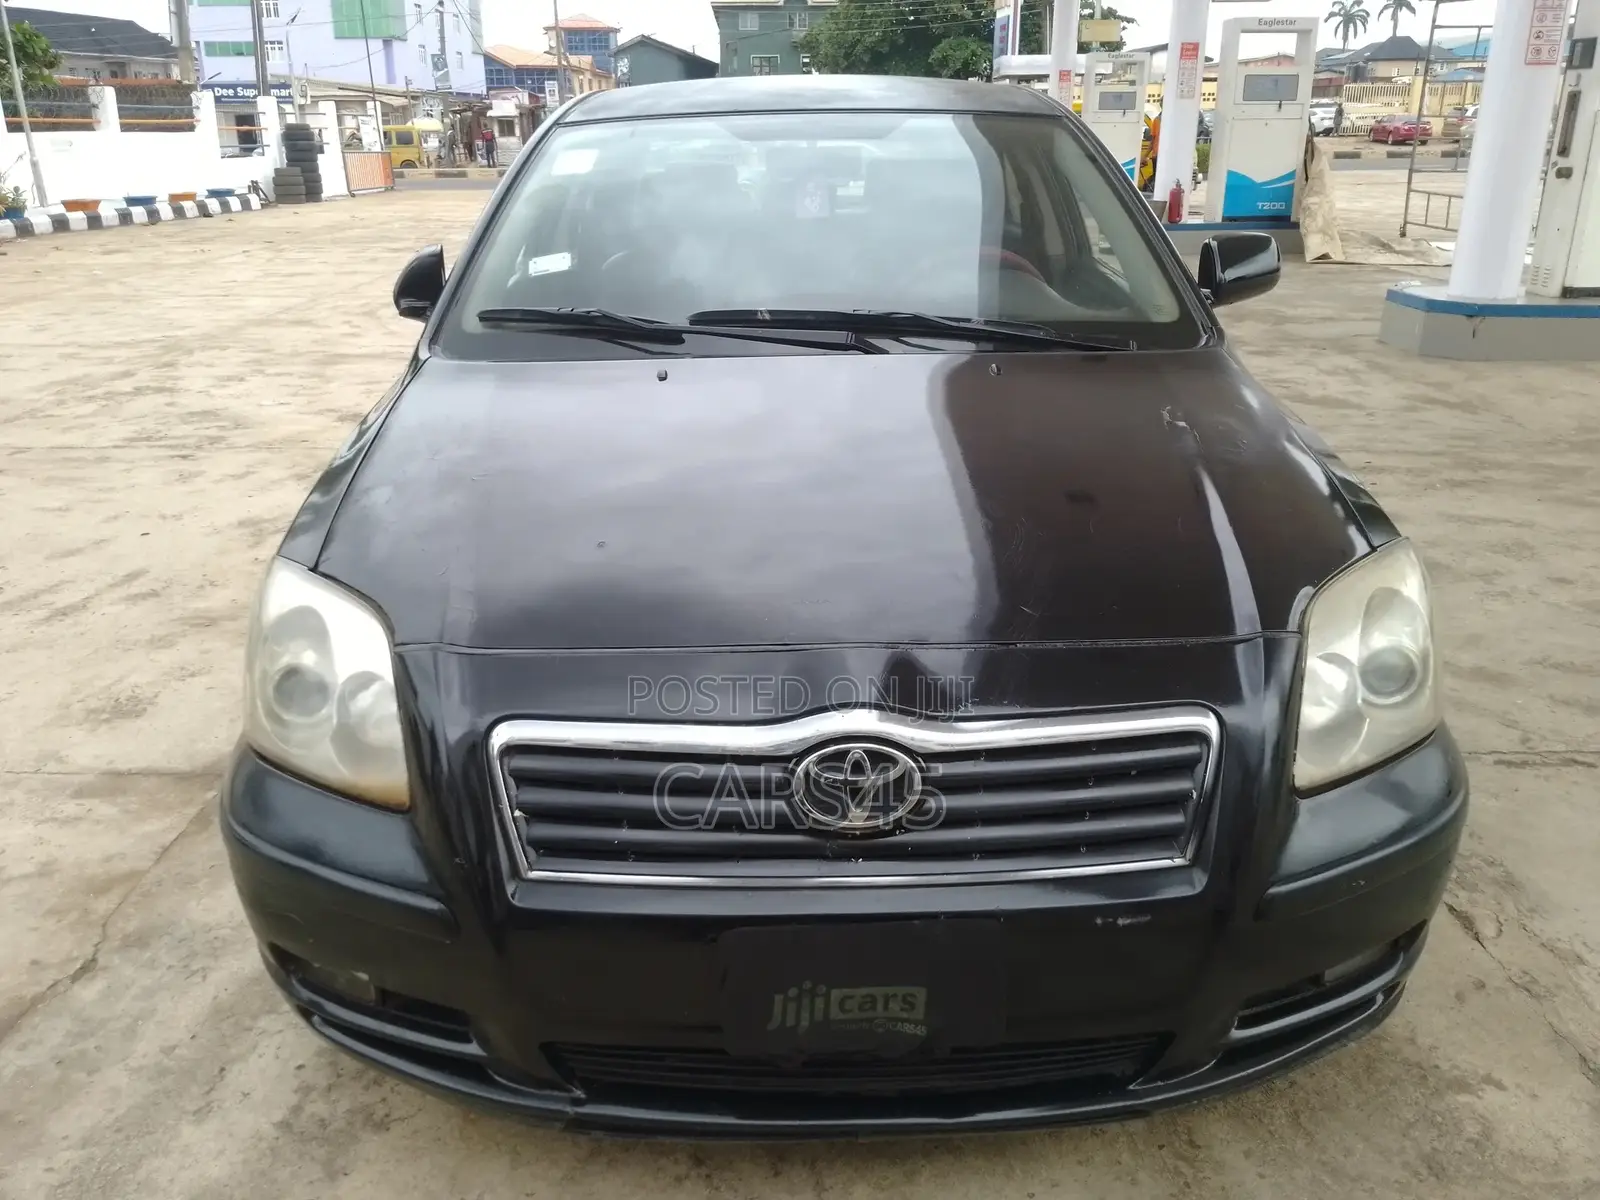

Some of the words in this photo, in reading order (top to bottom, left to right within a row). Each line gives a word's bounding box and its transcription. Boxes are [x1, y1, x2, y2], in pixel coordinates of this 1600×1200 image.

[1257, 17, 1297, 28] Eaglestar
[214, 87, 235, 97] Dee
[1256, 201, 1287, 210] T200
